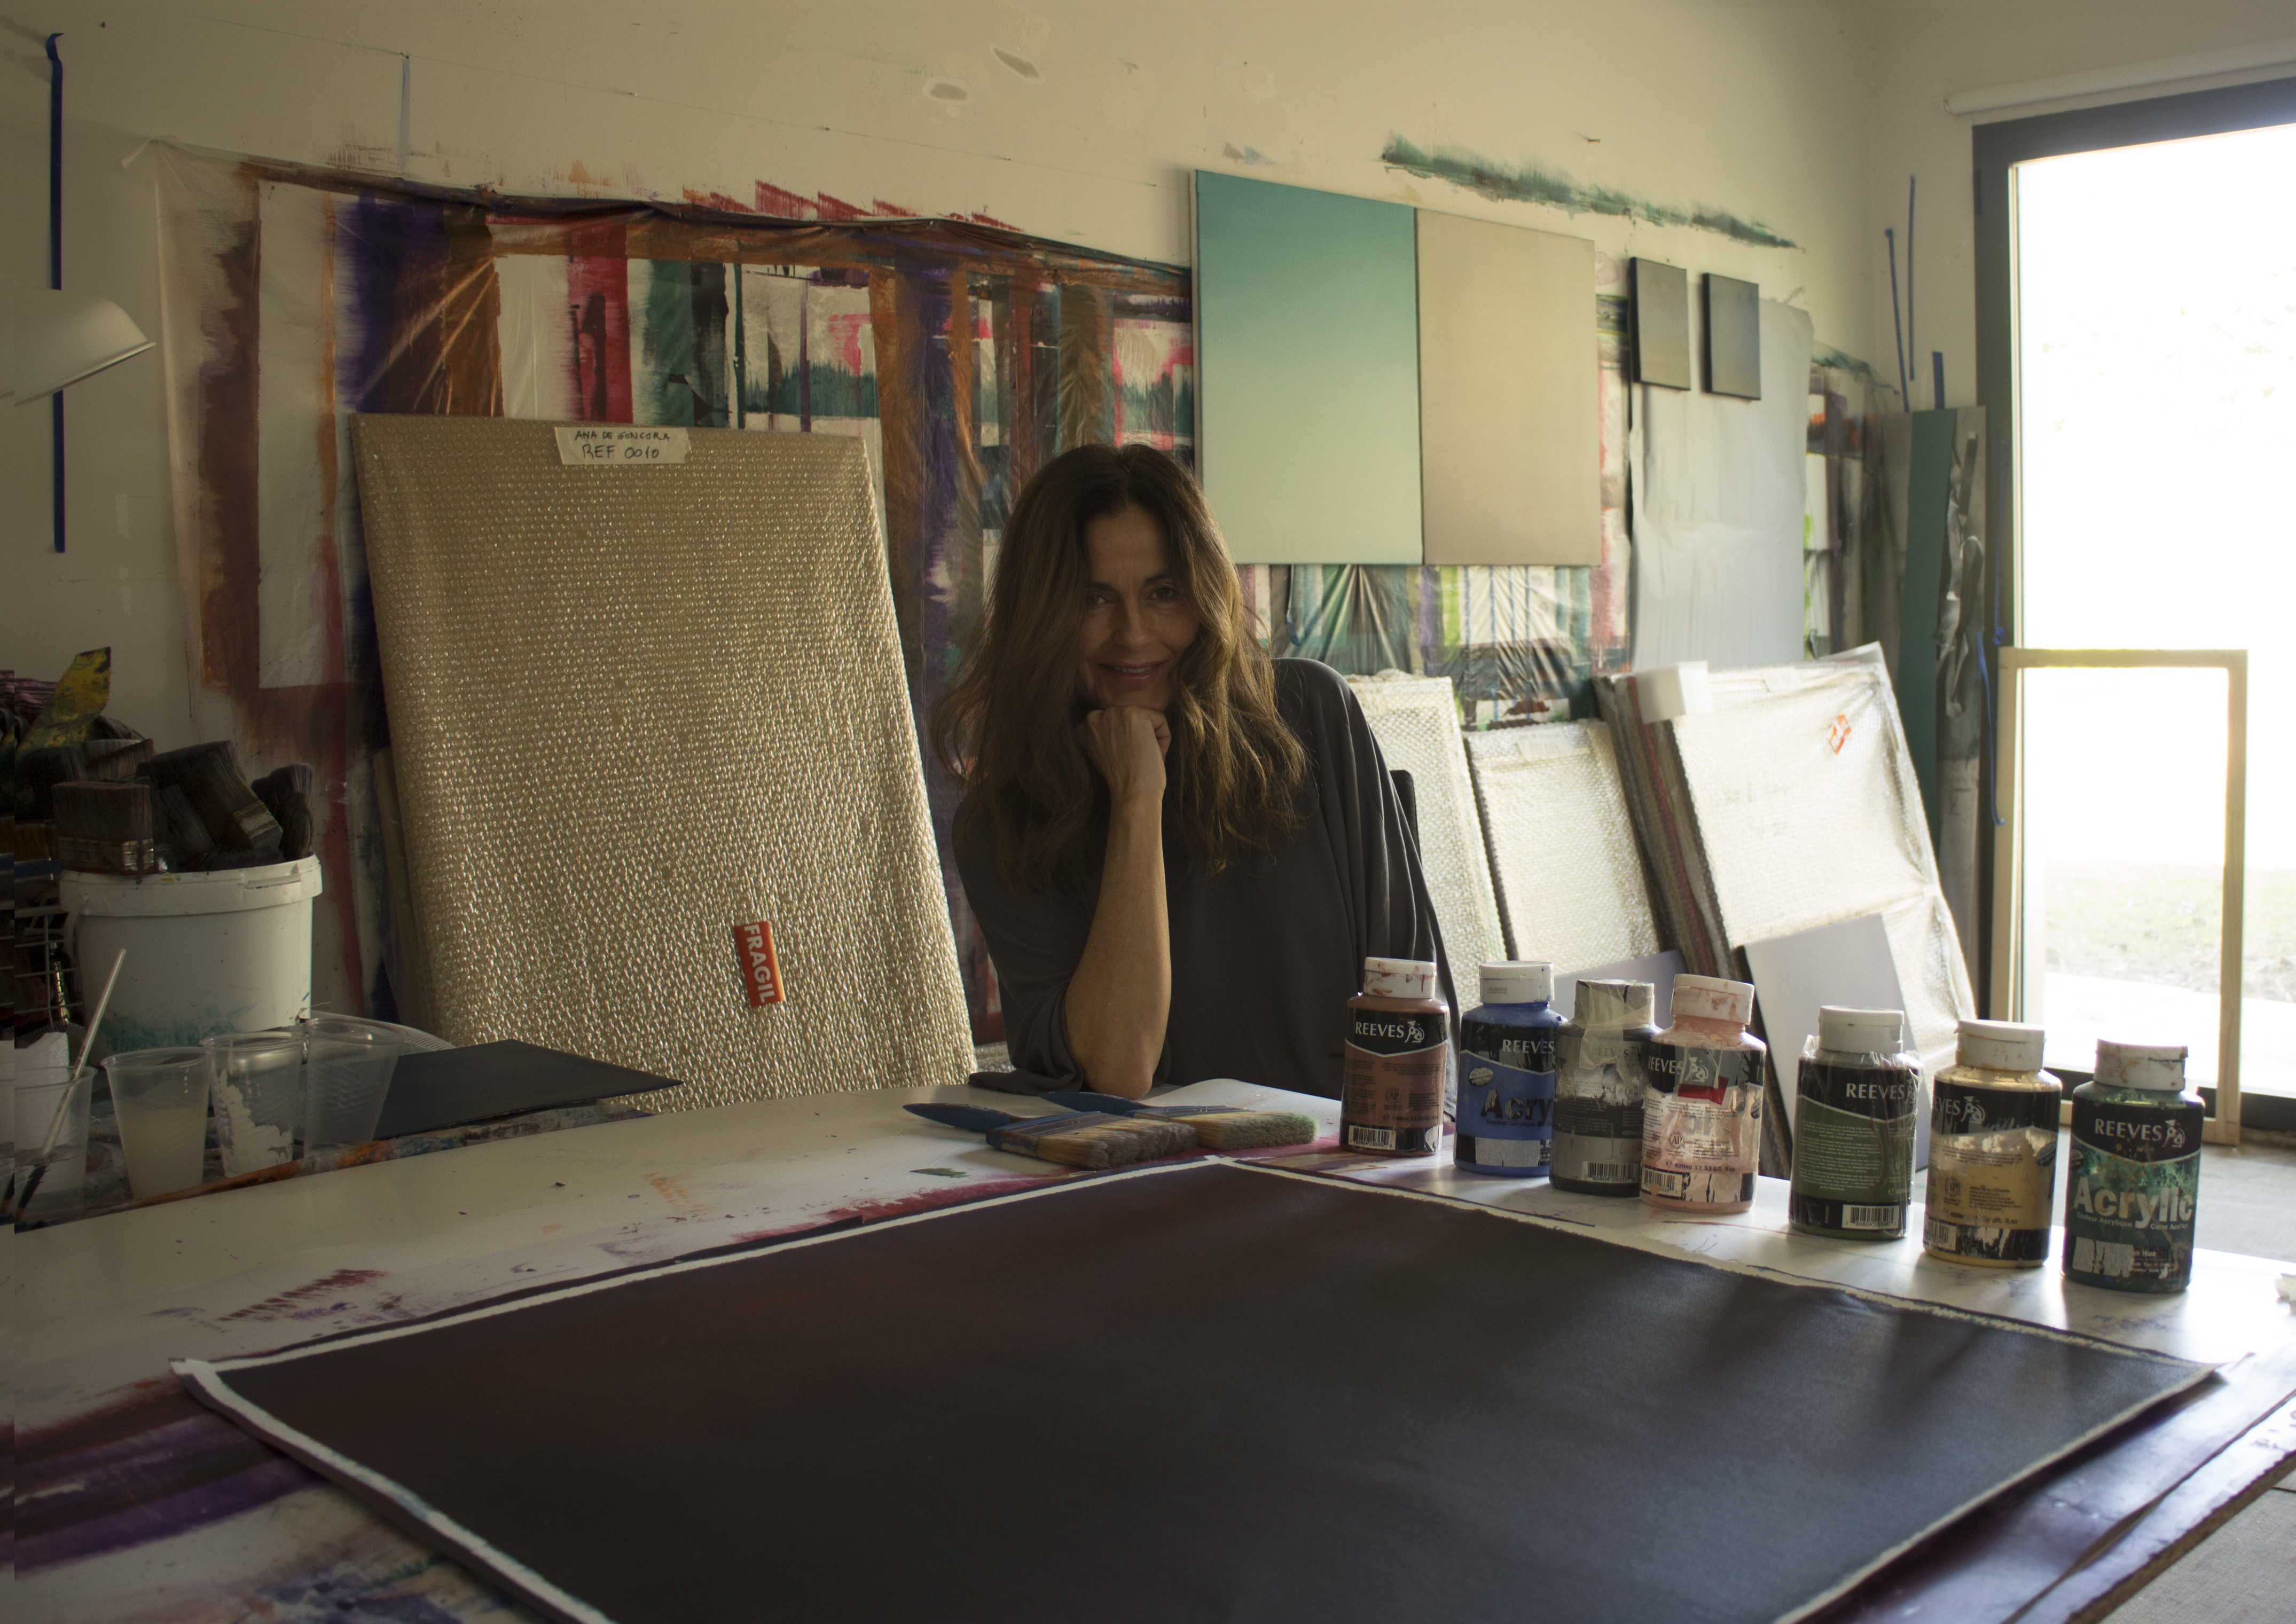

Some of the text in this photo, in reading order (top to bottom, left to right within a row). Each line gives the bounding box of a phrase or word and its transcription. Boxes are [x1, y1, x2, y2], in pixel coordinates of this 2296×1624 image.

[574, 430, 597, 441] ANA
[602, 430, 613, 439] DE
[582, 443, 660, 460] REF 0010
[744, 924, 774, 1003] FRAGIL
[1355, 1021, 1404, 1038] REEVES
[1502, 1039, 1554, 1054] REEVES
[1846, 1082, 1905, 1100] REEVES
[1480, 1088, 1553, 1127] Acry
[2094, 1118, 2162, 1141] REEVES
[1671, 1135, 1682, 1145] AP
[2073, 1176, 2193, 1228] Acrylic
[2076, 1211, 2098, 1222] Couleur
[2099, 1217, 2133, 1228] Acrylique
